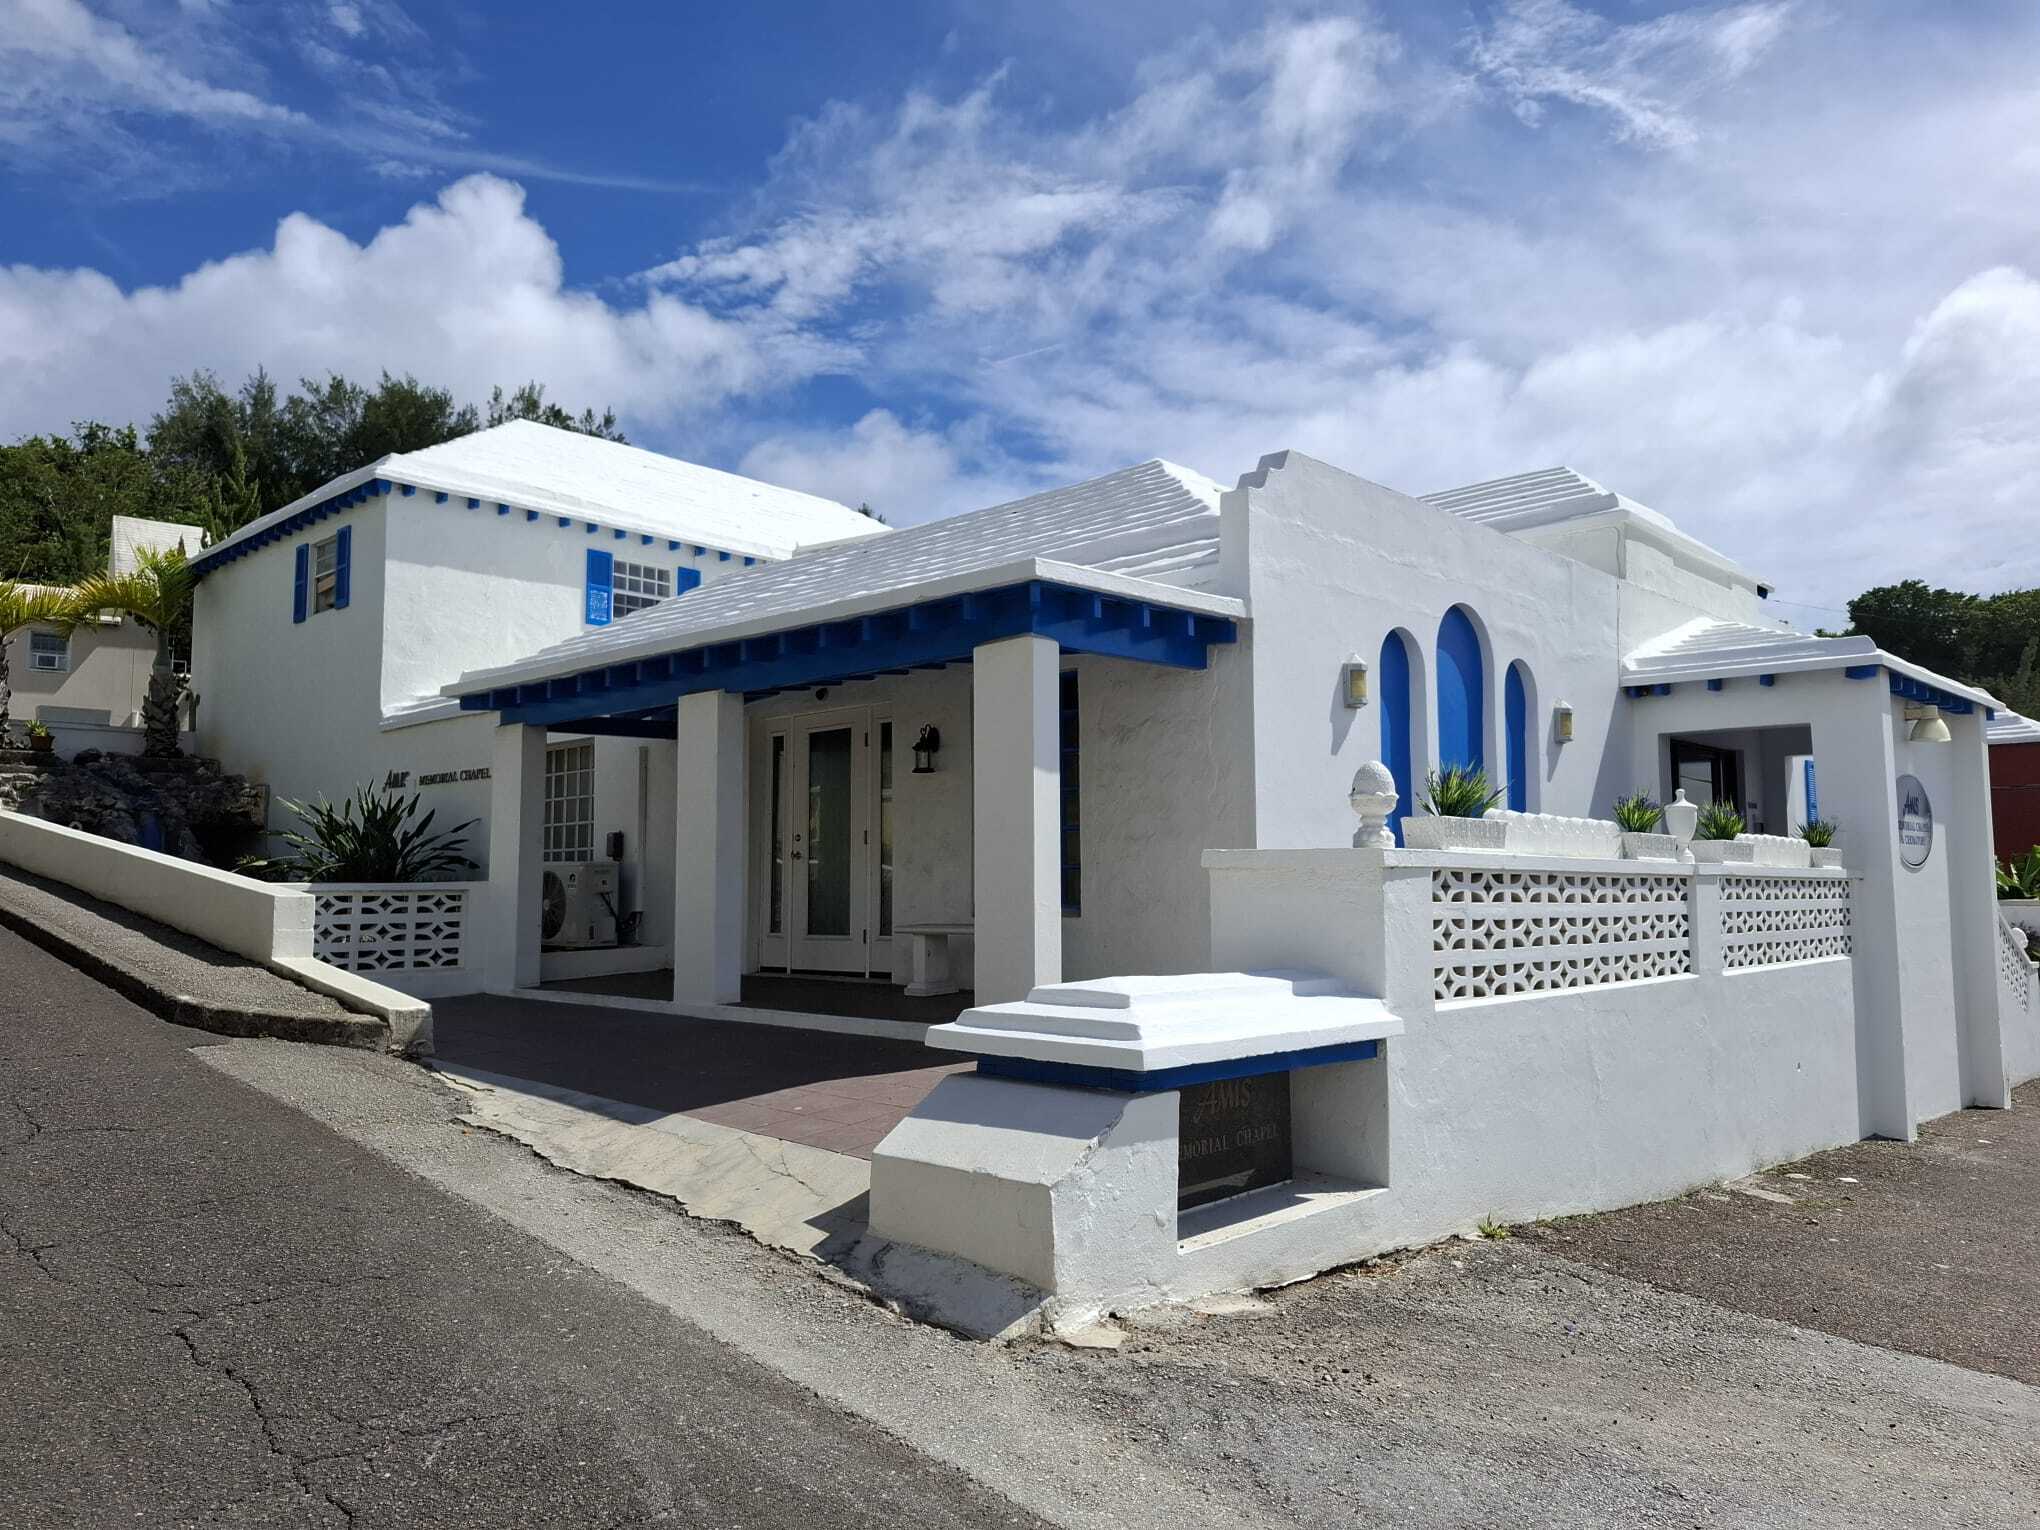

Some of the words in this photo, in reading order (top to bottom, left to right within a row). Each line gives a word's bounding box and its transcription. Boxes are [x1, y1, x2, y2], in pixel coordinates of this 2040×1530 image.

[419, 771, 458, 786] MEMORIAL
[460, 768, 492, 781] CHAPEL
[1236, 1124, 1281, 1147] CHAPEL
